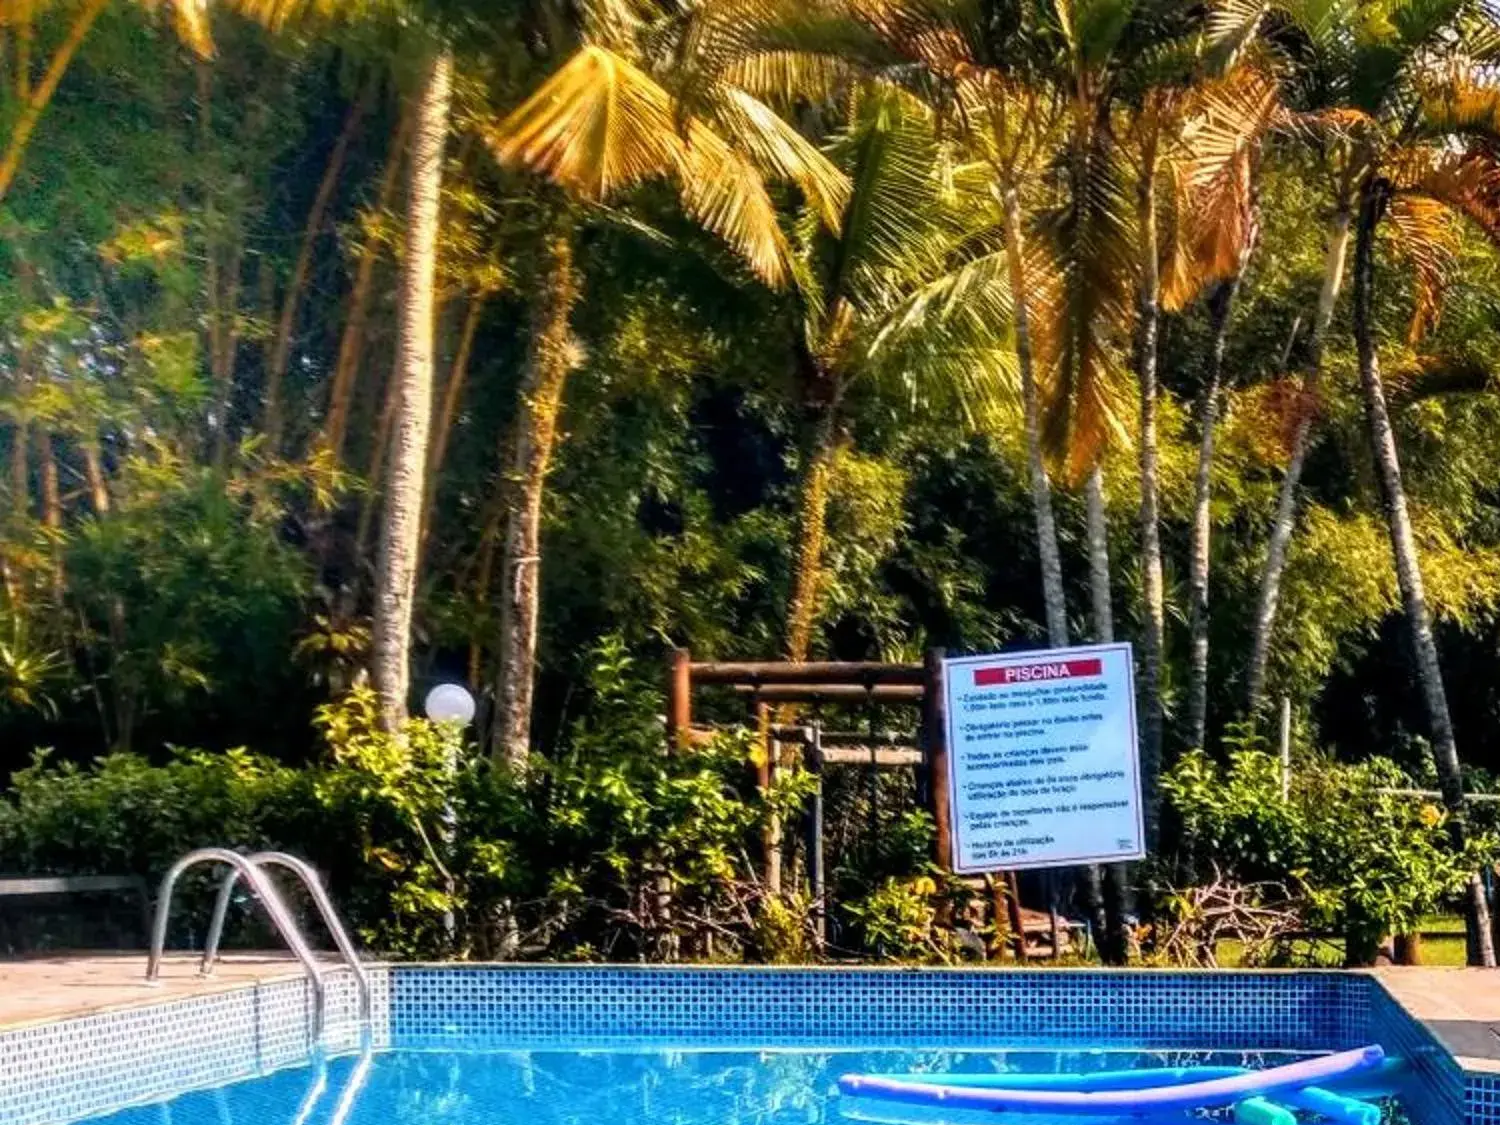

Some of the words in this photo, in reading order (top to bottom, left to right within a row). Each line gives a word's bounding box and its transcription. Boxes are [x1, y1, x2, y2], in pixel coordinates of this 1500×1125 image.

[1005, 664, 1071, 682] PISCINA
[1013, 719, 1039, 729] passar
[977, 732, 1000, 740] entrar
[966, 752, 990, 761] Todas
[1004, 749, 1039, 759] crianças
[966, 759, 1026, 771] acompanhadas
[967, 781, 1004, 791] Crianças
[967, 789, 1006, 800] utilização
[1079, 800, 1128, 811] responsável
[972, 838, 1002, 849] Horário
[1015, 835, 1055, 846] utilização
